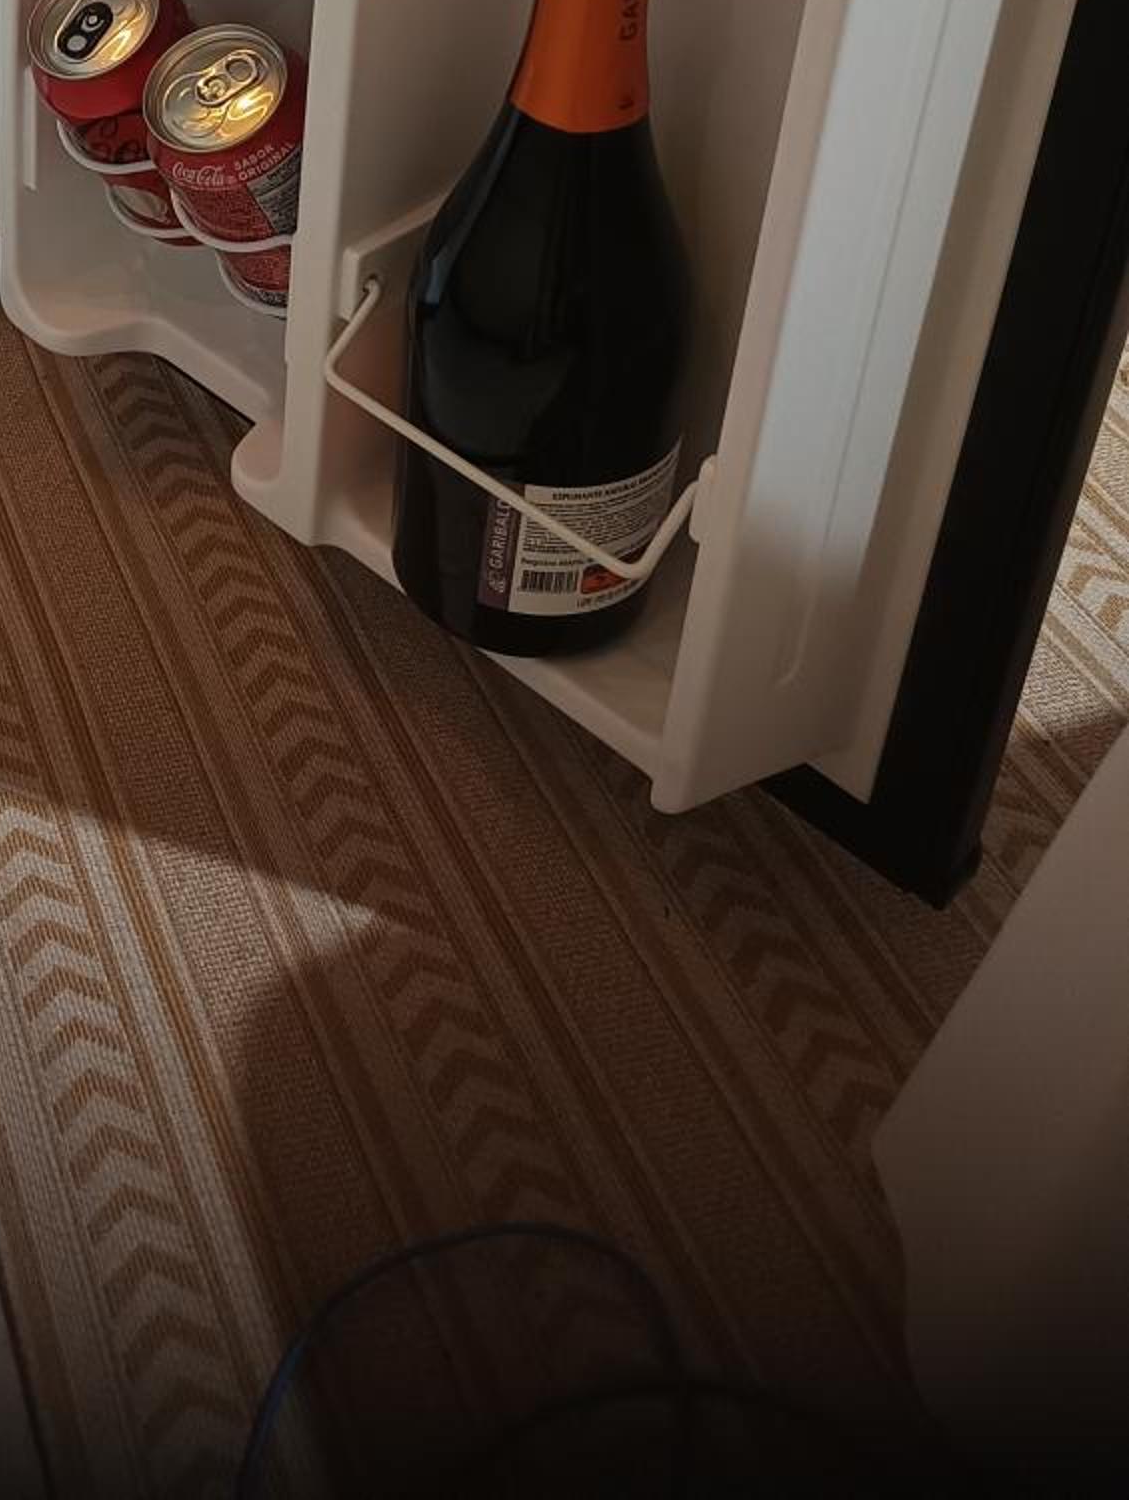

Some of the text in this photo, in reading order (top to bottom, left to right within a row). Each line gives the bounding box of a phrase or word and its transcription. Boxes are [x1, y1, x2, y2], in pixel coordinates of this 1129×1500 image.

[233, 142, 276, 172] SABOR
[237, 142, 296, 182] ORIGINAL
[489, 499, 512, 570] GARIBALD
